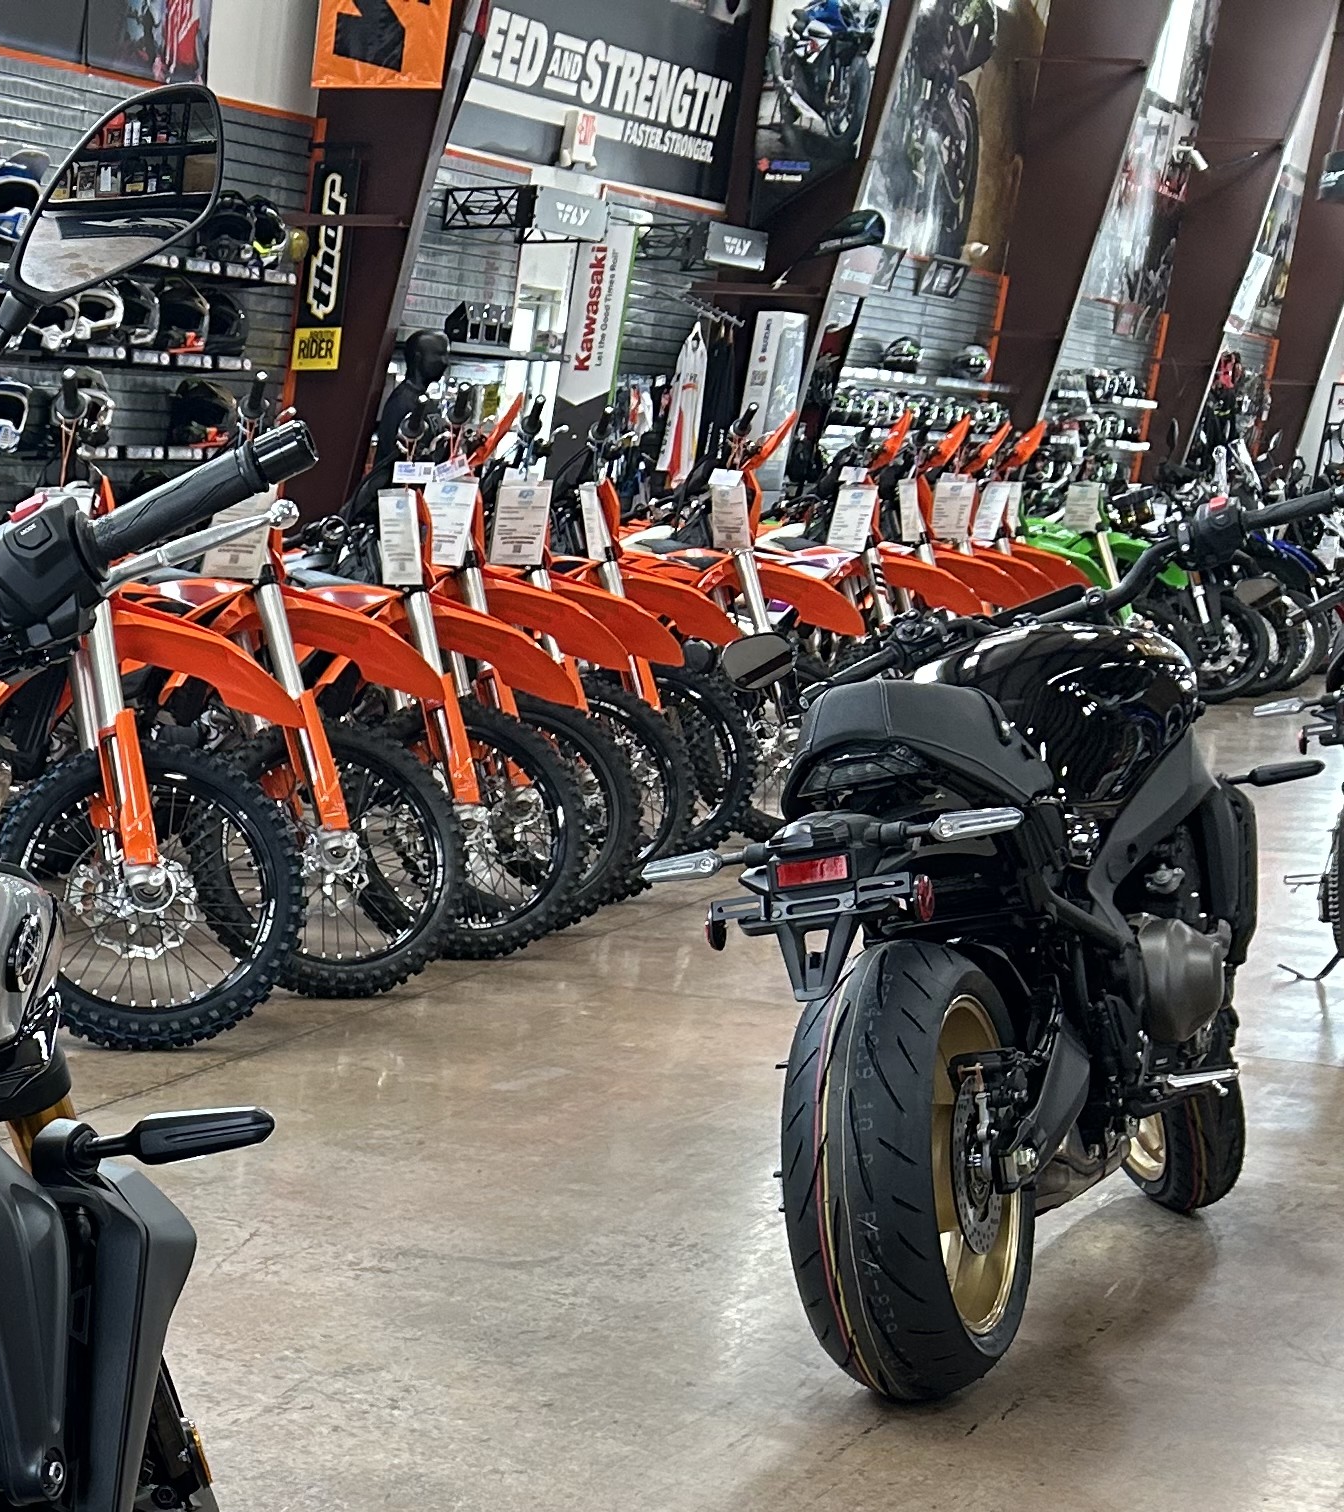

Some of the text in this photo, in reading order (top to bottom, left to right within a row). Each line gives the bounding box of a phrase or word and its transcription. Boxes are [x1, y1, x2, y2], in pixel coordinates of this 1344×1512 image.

[547, 47, 583, 82] AND
[580, 38, 733, 137] STRENGTH
[297, 337, 334, 360] RIDER
[573, 245, 609, 372] Kawasaki
[594, 349, 605, 368] Let
[600, 303, 612, 332] Good
